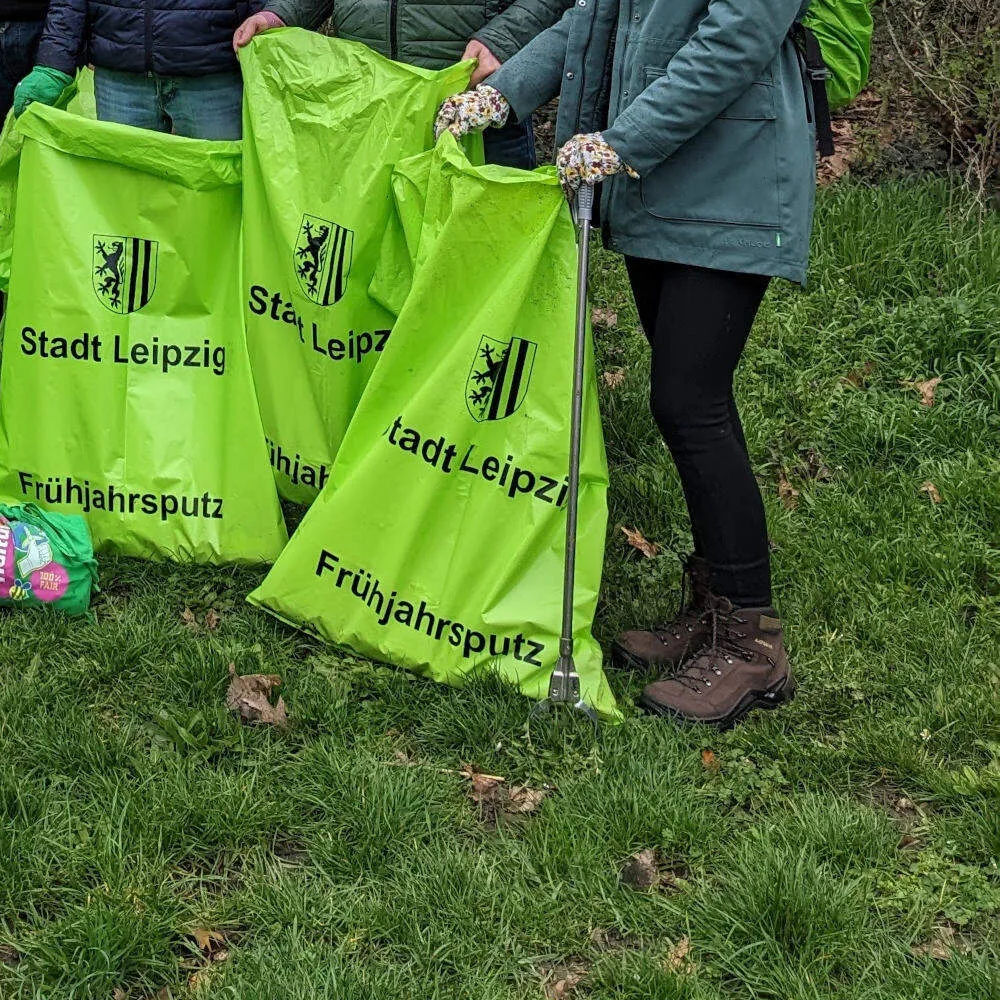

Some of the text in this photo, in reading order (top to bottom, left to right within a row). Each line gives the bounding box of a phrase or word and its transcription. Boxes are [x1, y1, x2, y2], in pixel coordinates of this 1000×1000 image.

[20, 326, 226, 375] Stadt Leipzig
[249, 285, 392, 363] Stat Leipz
[382, 415, 457, 473] tadt
[459, 444, 569, 507] Leipzi
[18, 471, 223, 521] Frühjahrsputz
[40, 580, 60, 591] FAIR
[315, 549, 545, 667] Frühjahrsputz
